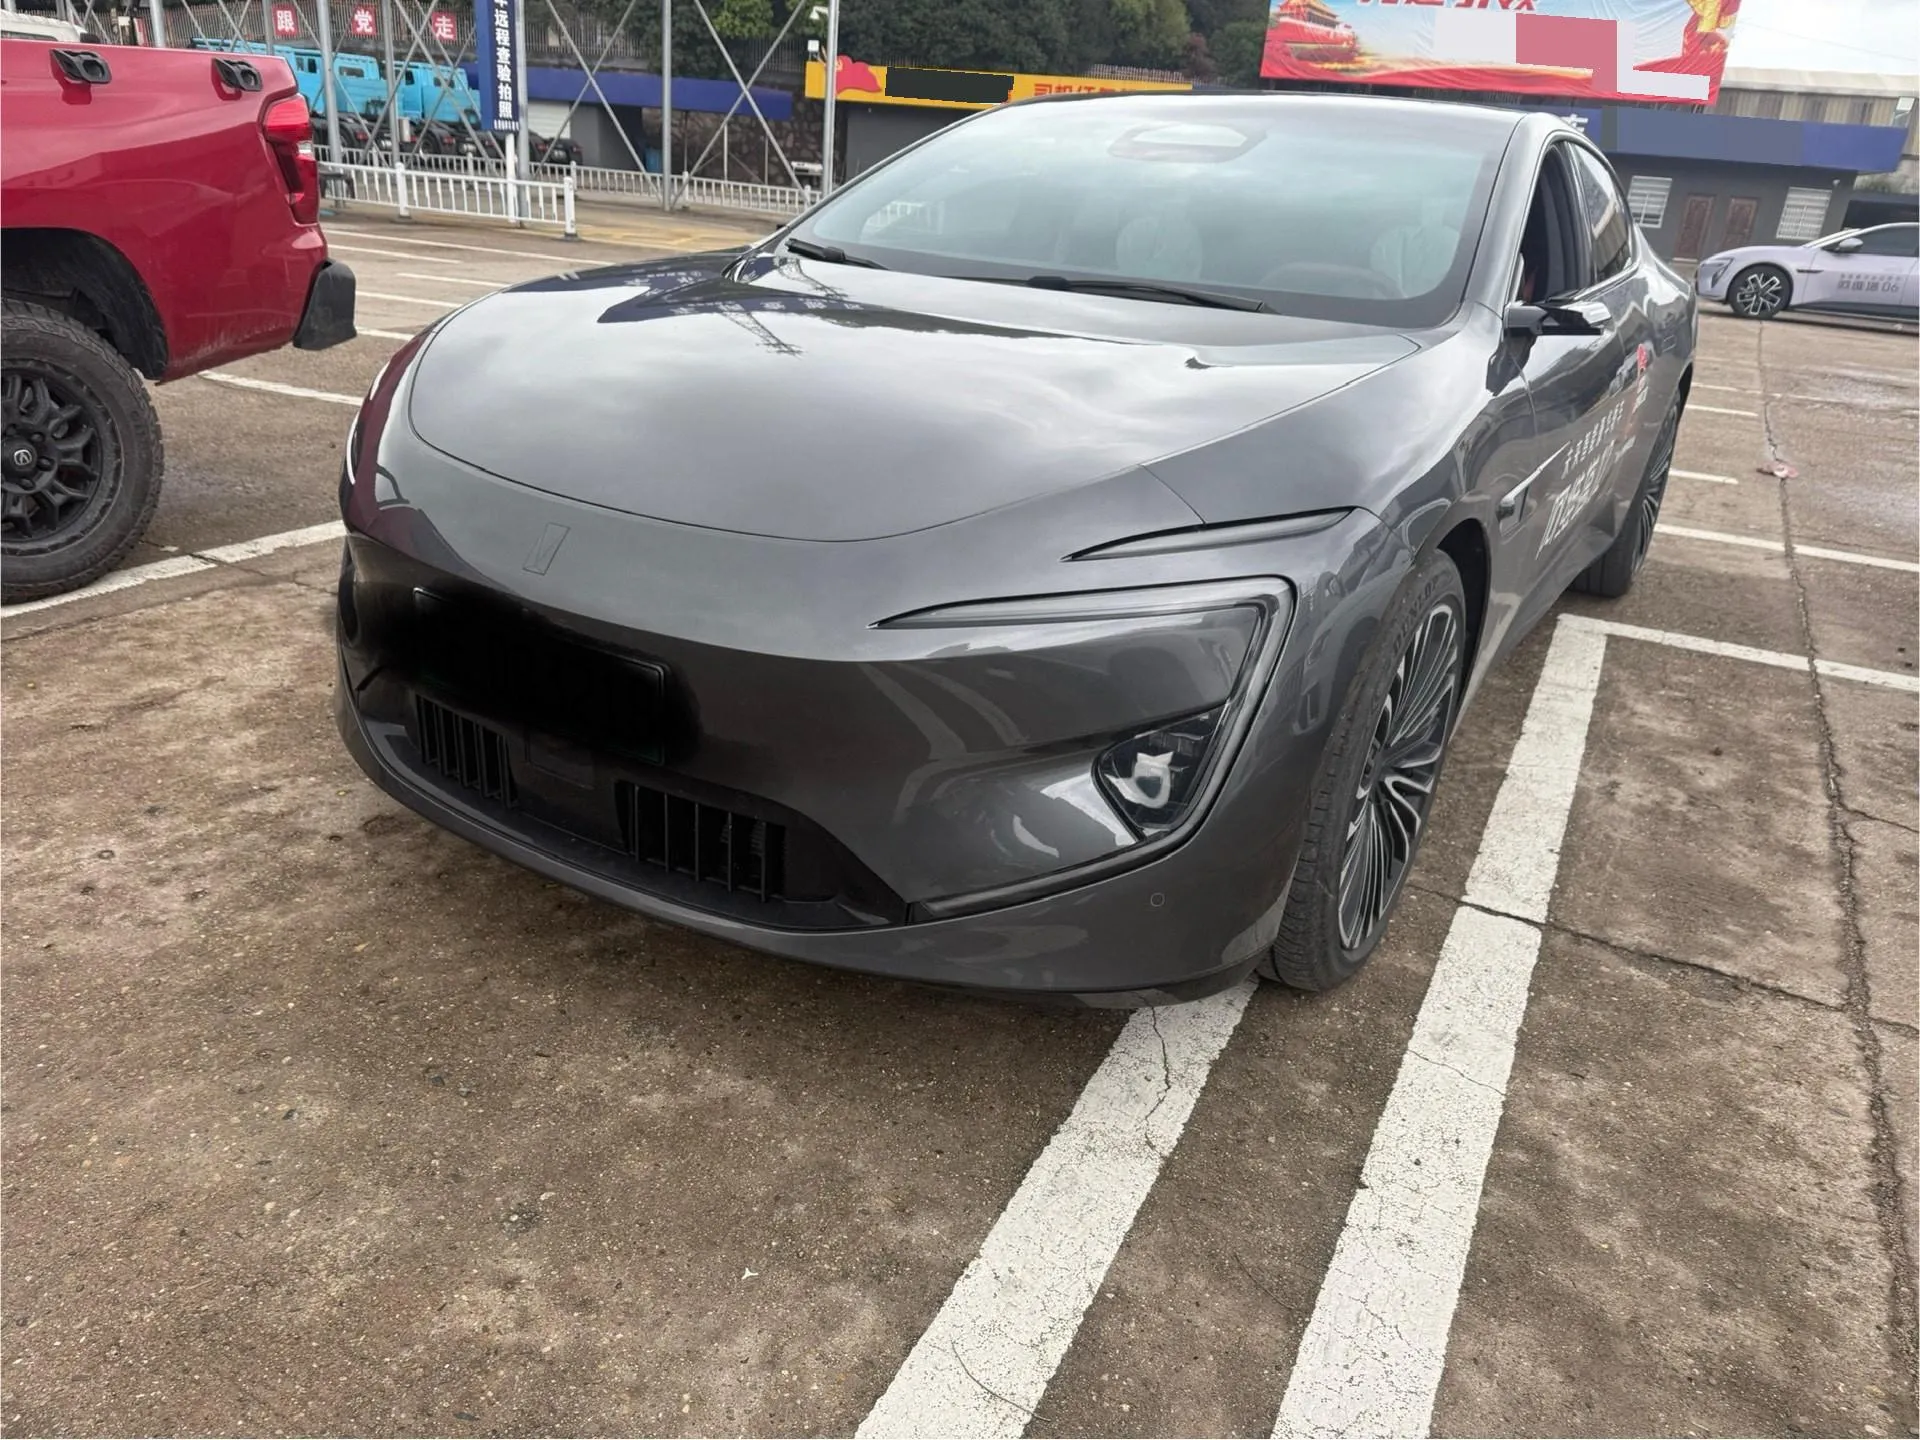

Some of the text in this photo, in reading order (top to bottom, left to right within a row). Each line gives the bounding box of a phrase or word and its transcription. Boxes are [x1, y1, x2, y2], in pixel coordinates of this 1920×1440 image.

[276, 10, 295, 32] 跟
[354, 9, 373, 33] 党
[434, 16, 454, 39] 走
